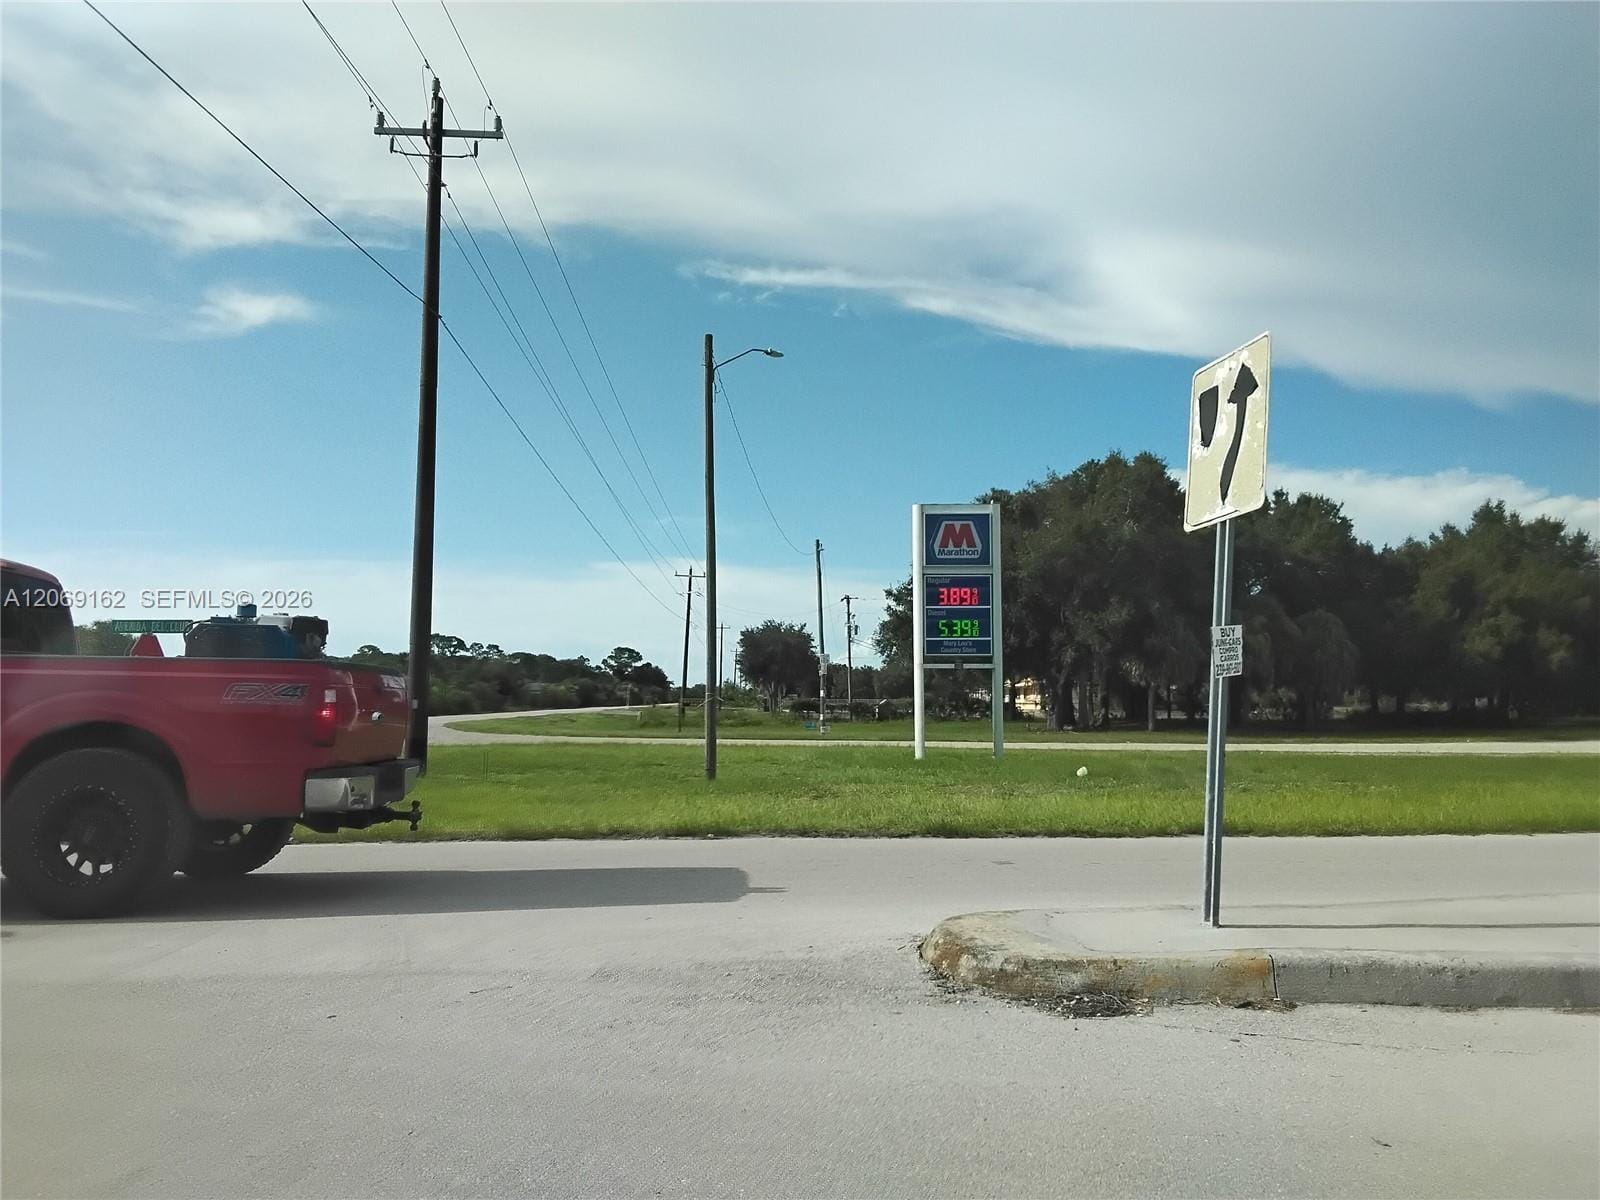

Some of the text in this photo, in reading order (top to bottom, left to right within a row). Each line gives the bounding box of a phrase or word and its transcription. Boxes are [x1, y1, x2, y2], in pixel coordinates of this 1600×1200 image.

[937, 548, 979, 556] Marathon
[927, 577, 951, 585] Regular
[938, 587, 970, 605] 3.89
[938, 619, 970, 637] 5.39
[1220, 627, 1235, 637] BUY
[1219, 646, 1238, 654] COMPRO
[223, 682, 309, 700] FX4
